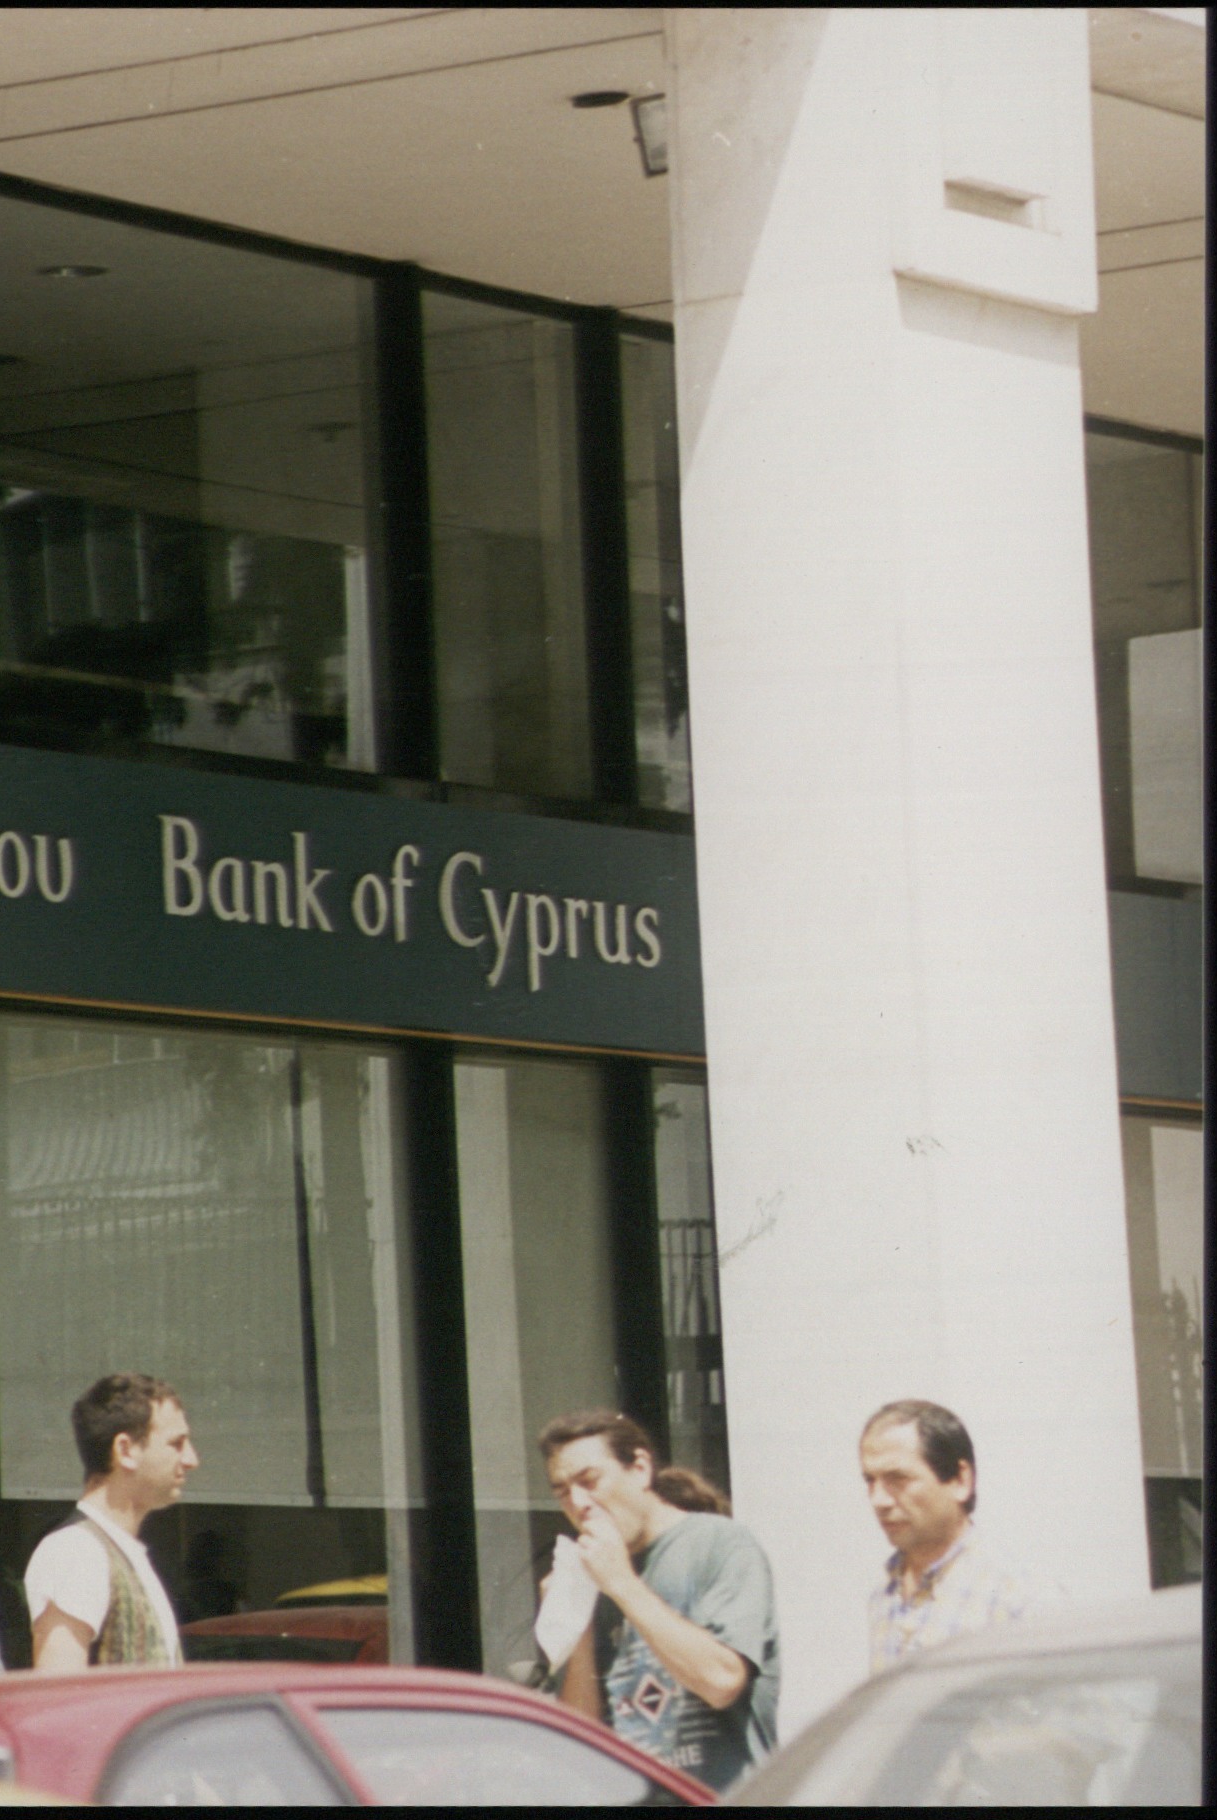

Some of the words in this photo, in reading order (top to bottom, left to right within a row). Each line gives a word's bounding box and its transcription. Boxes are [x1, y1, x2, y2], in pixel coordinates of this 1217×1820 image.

[158, 814, 334, 933] Bank
[352, 844, 420, 943] of
[439, 851, 662, 992] Cyprus
